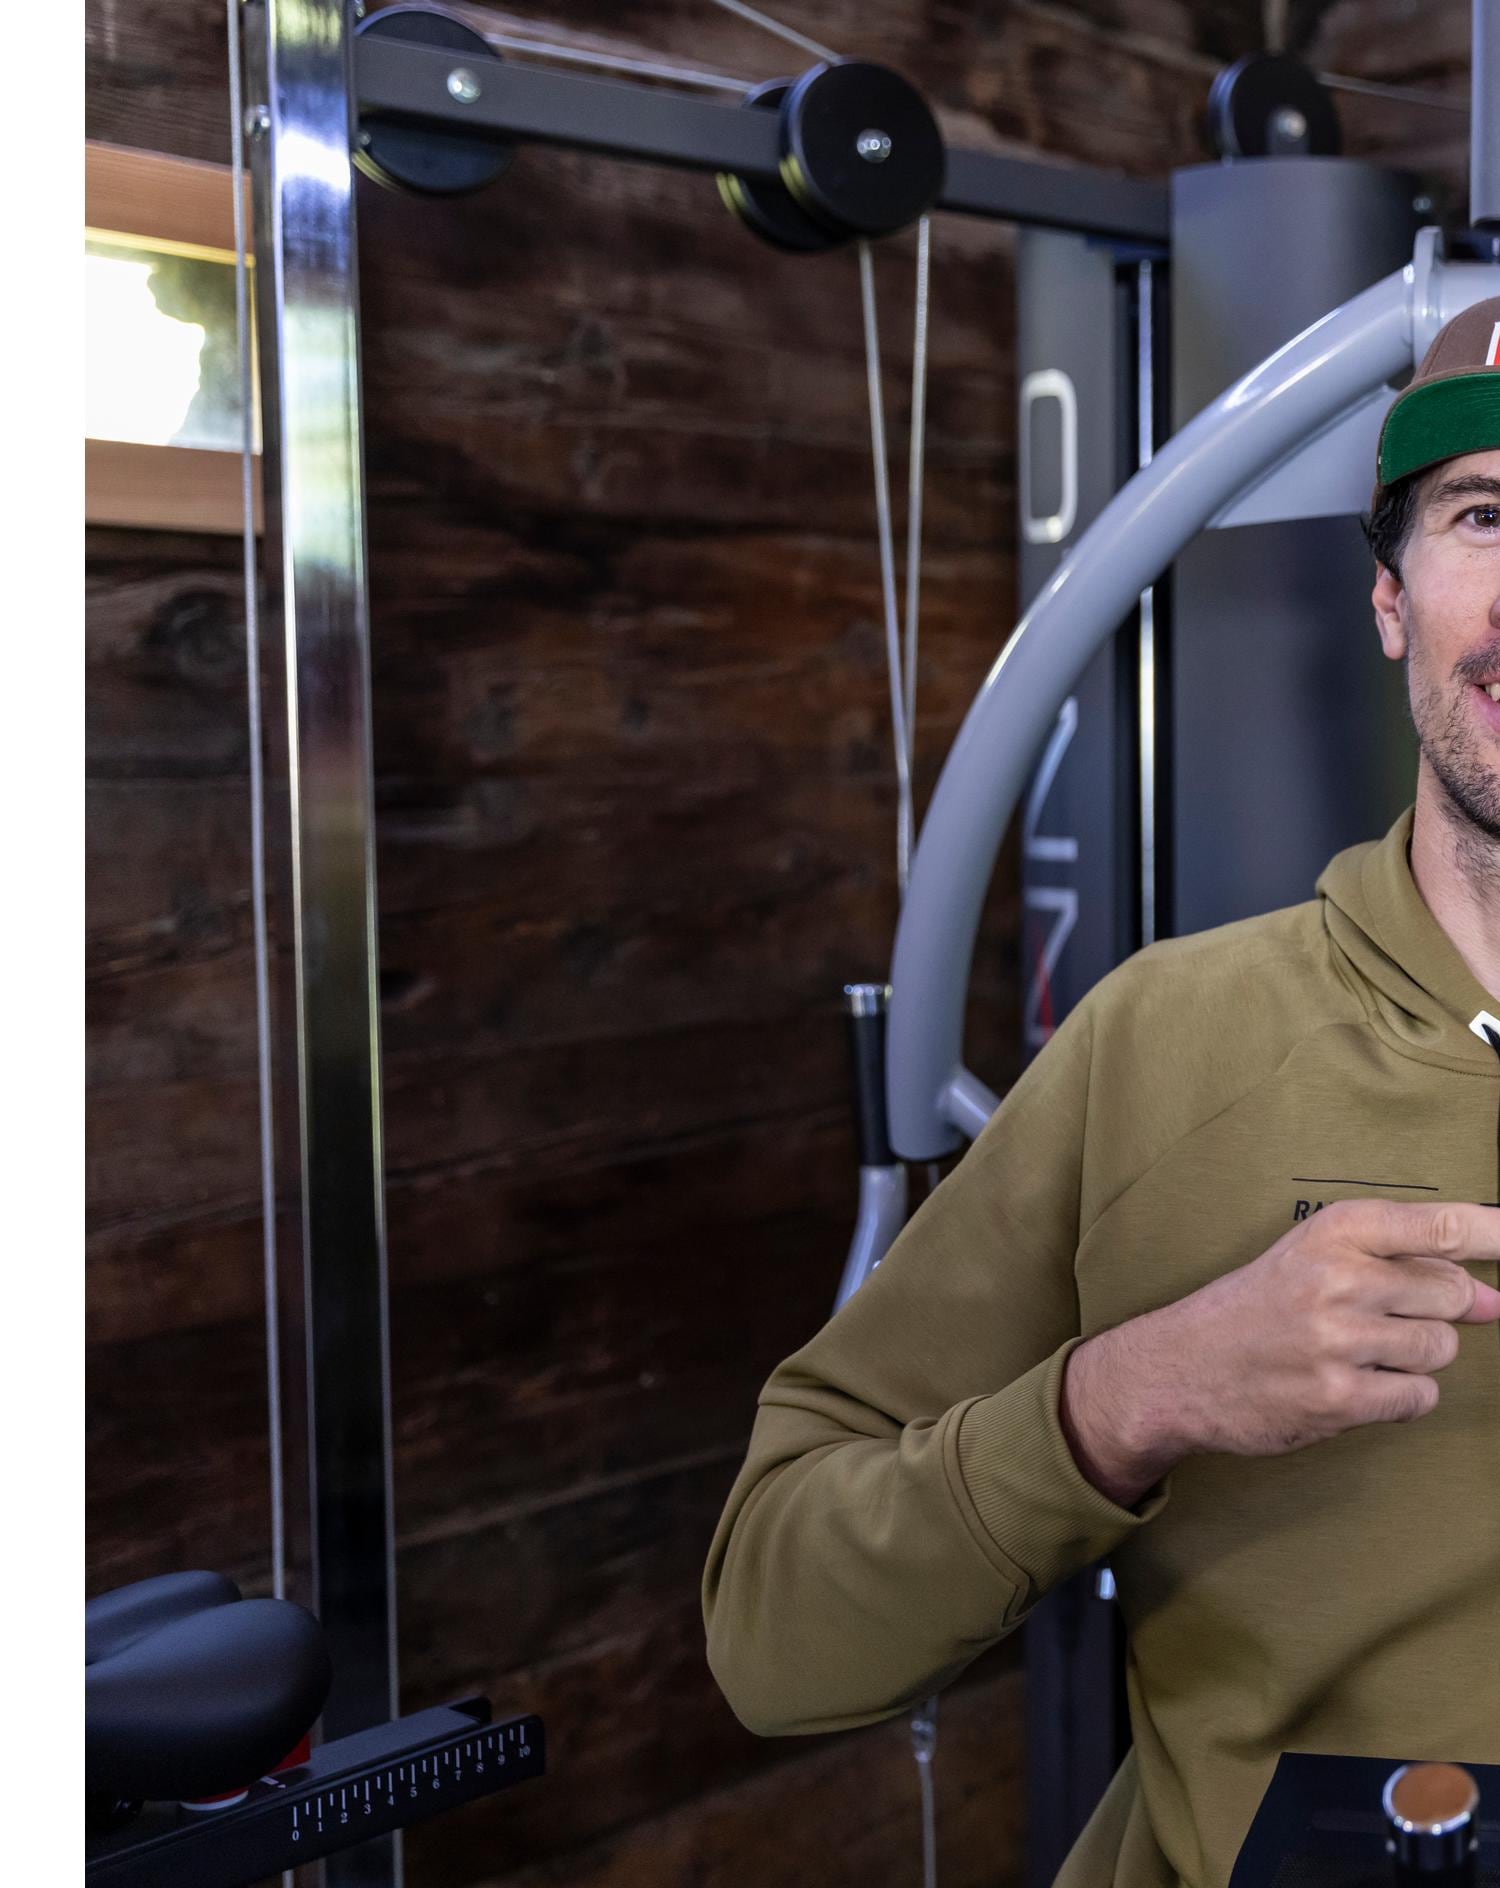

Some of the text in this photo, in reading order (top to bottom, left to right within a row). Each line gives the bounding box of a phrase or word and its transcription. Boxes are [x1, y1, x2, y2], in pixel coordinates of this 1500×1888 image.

[292, 1831, 299, 1841] 0
[317, 1822, 323, 1832] 1
[341, 1813, 348, 1823] 2
[364, 1804, 371, 1815] 3
[387, 1795, 394, 1805] 4
[410, 1787, 417, 1797] 5
[433, 1779, 440, 1789] 6
[456, 1771, 462, 1781] 7
[477, 1763, 484, 1773] 8
[498, 1755, 505, 1765] 9
